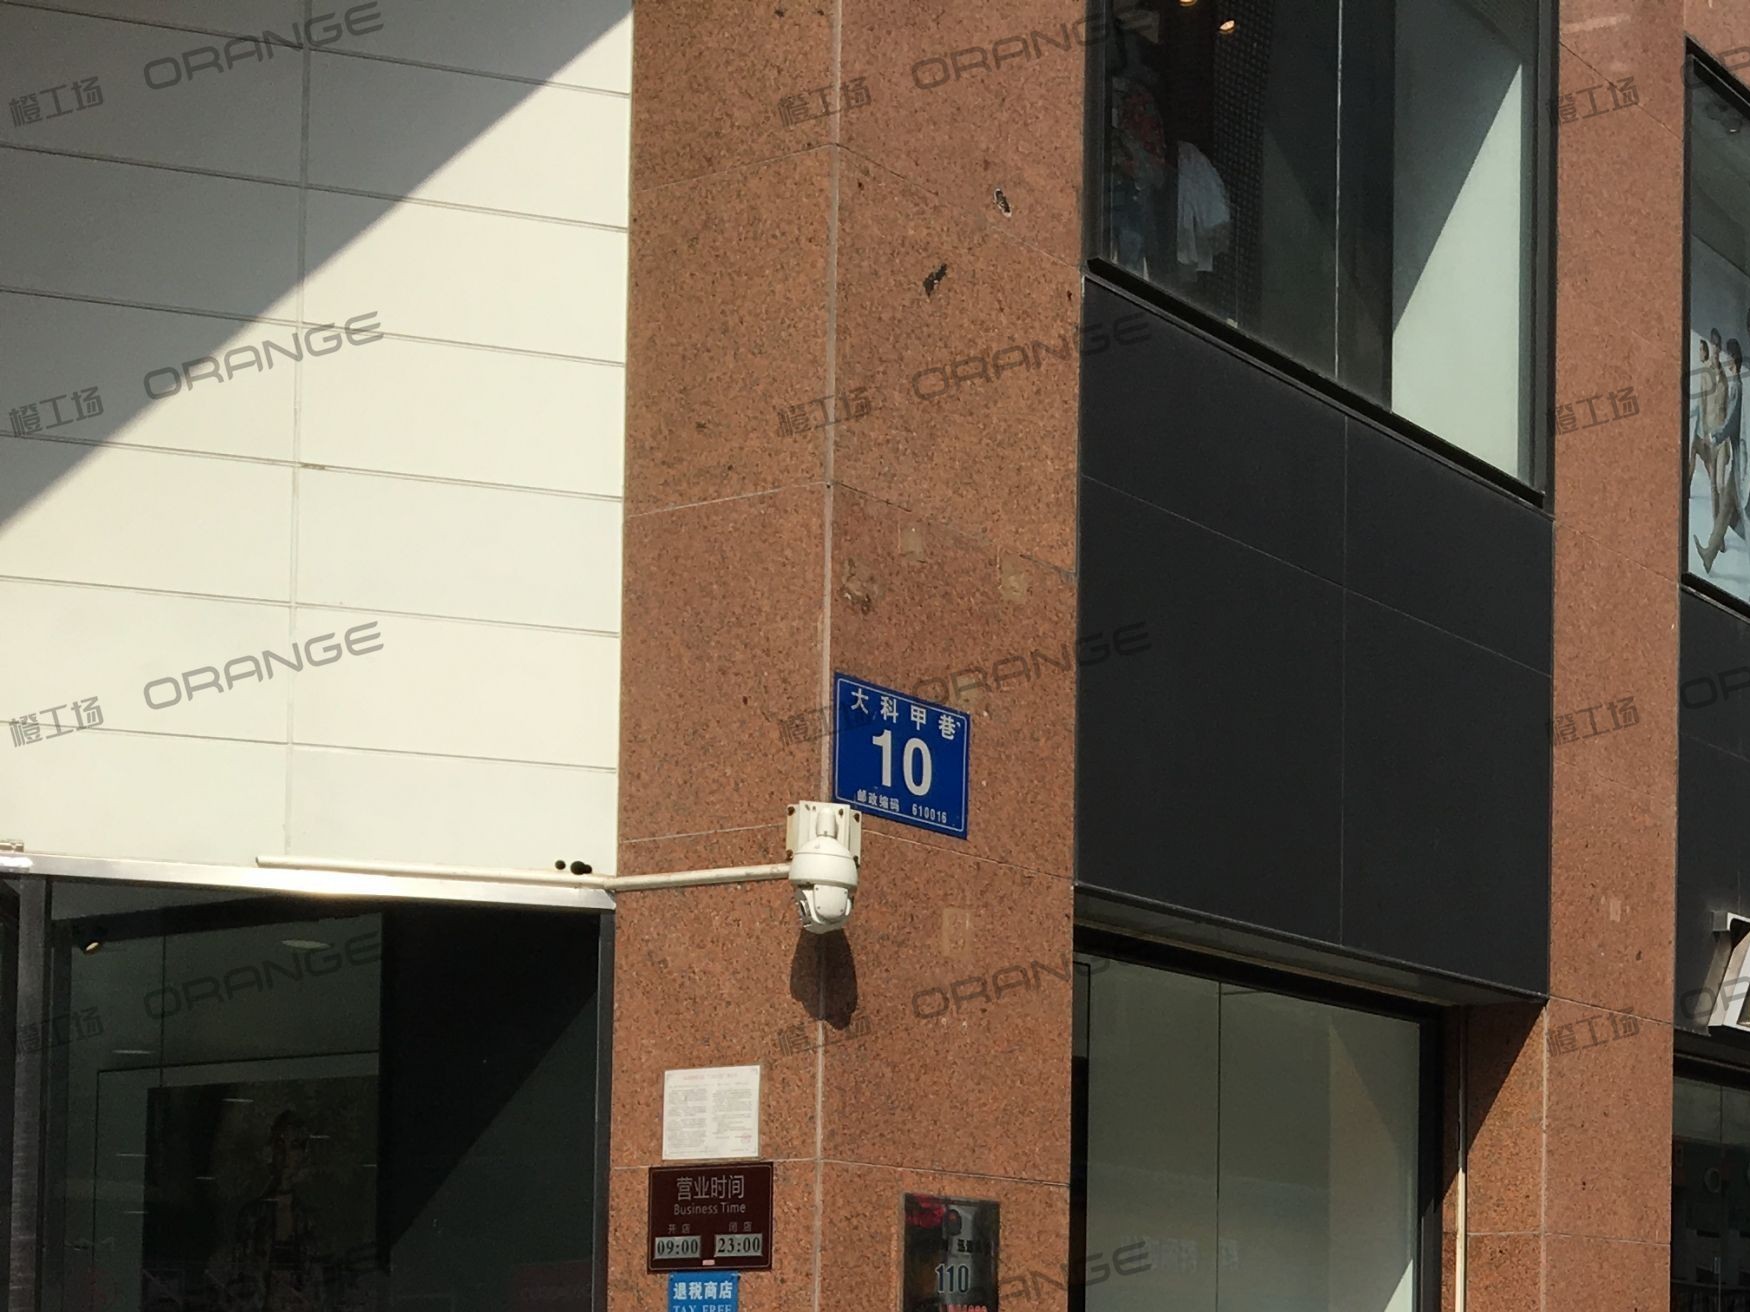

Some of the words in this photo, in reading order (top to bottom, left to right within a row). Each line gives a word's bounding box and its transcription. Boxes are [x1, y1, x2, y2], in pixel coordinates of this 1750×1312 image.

[851, 688, 961, 740] 大科甲巷
[872, 729, 932, 796] 10
[856, 789, 900, 812] 邮政编码
[911, 803, 947, 823] 610016
[676, 1175, 745, 1201] 营业时间
[673, 1203, 718, 1216] Business
[721, 1201, 746, 1214] Time
[657, 1239, 698, 1256] 09:00
[717, 1236, 761, 1253] 23:00
[673, 1281, 733, 1300] 退税商店
[935, 1263, 970, 1293] 110
